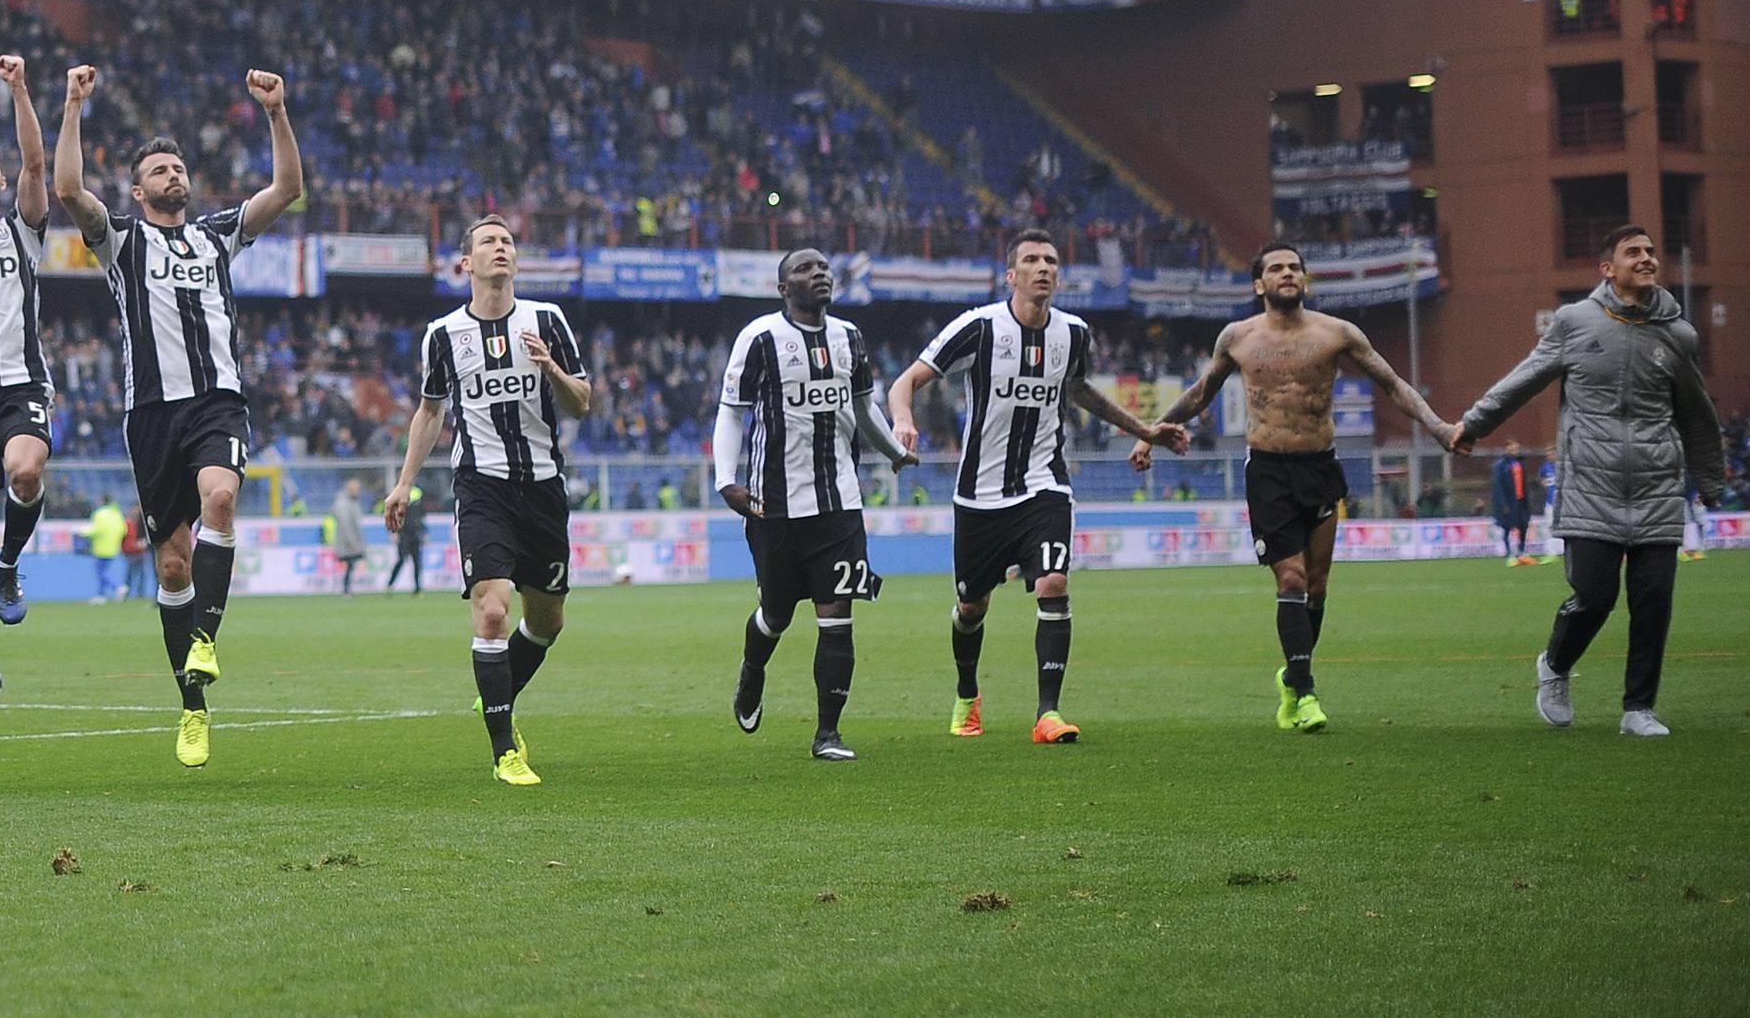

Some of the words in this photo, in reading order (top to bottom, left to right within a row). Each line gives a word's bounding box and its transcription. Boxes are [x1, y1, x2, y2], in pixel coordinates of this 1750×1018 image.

[150, 257, 216, 288] Jeep
[466, 373, 537, 400] Jeep
[787, 383, 850, 408] Jeep
[995, 377, 1059, 405] Jeep
[28, 401, 46, 424] 5
[1040, 542, 1068, 570] 17
[833, 560, 869, 596] 22
[485, 703, 510, 715] JUVE
